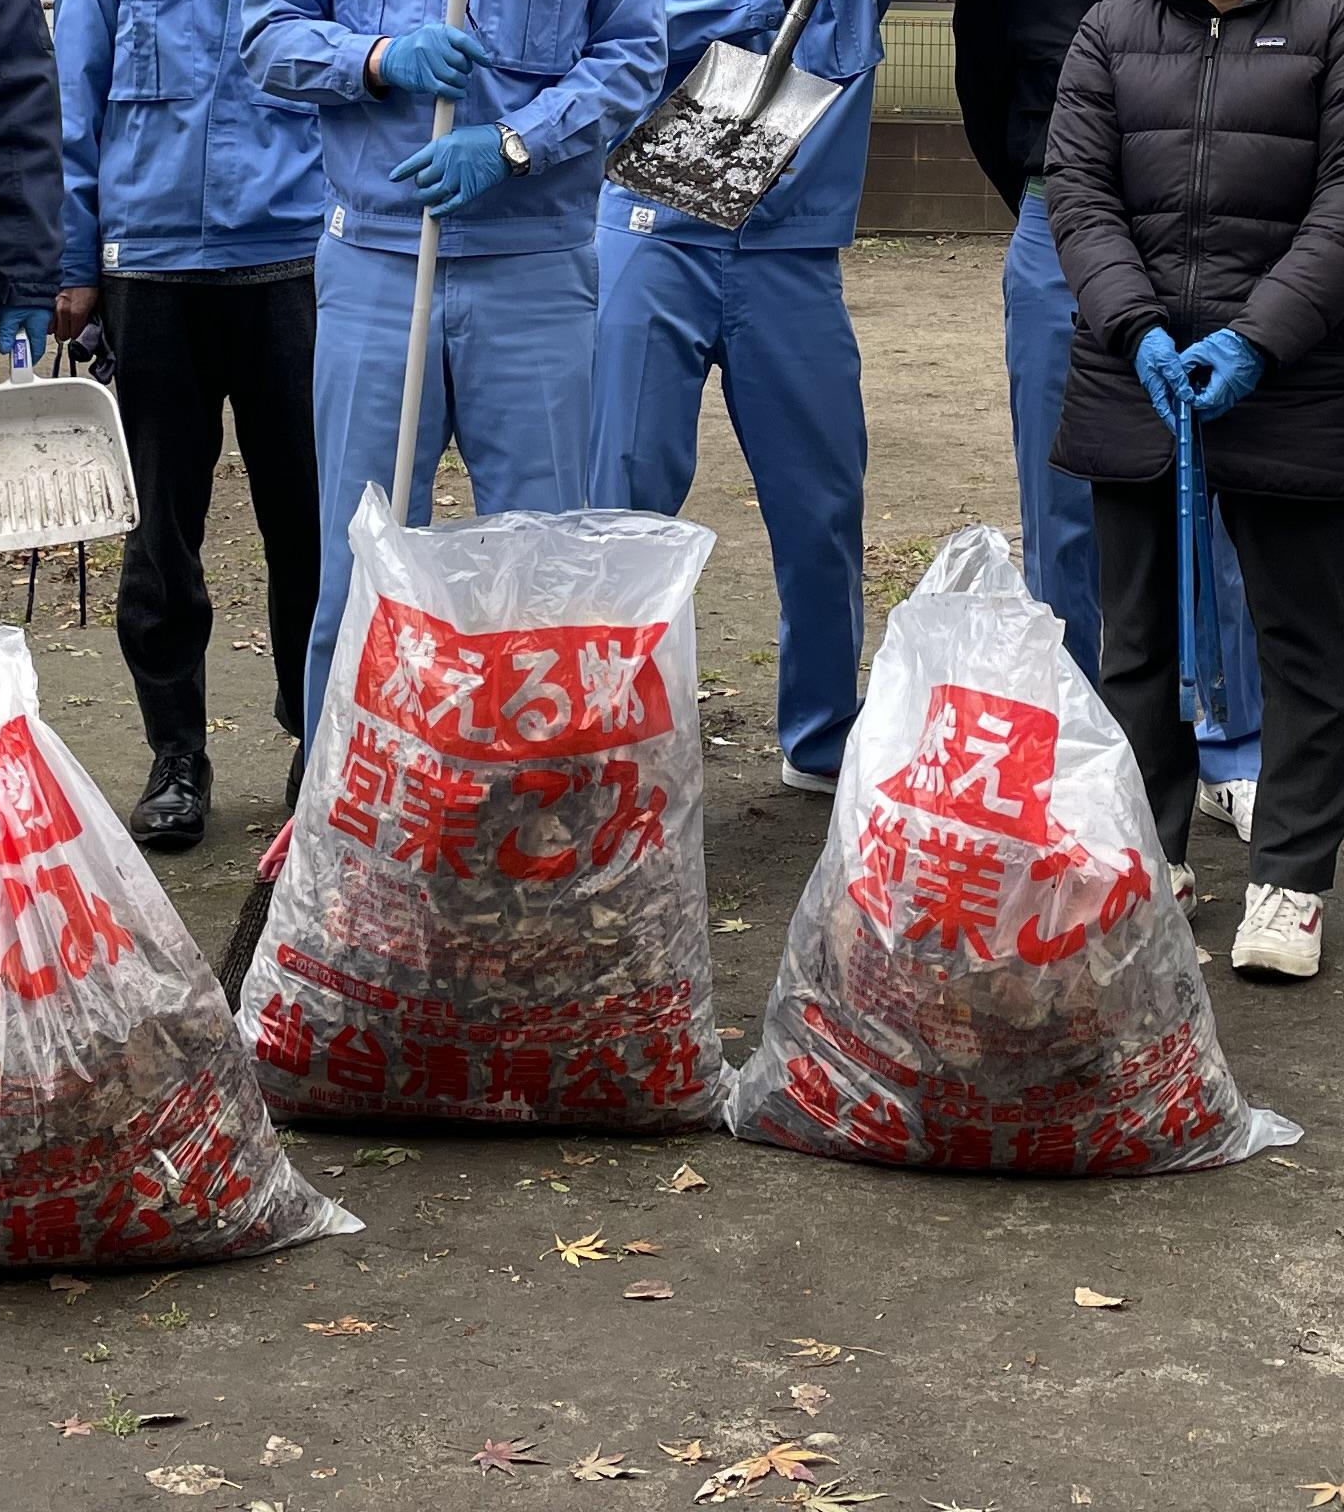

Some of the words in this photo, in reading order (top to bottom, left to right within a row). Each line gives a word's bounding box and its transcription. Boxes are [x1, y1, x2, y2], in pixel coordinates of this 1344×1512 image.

[380, 619, 648, 744] 燃える物
[329, 724, 668, 881] 営業ごみ
[256, 992, 706, 1110] 仙台清掃公社
[401, 996, 461, 1022] TEL
[924, 1075, 986, 1101] TEL
